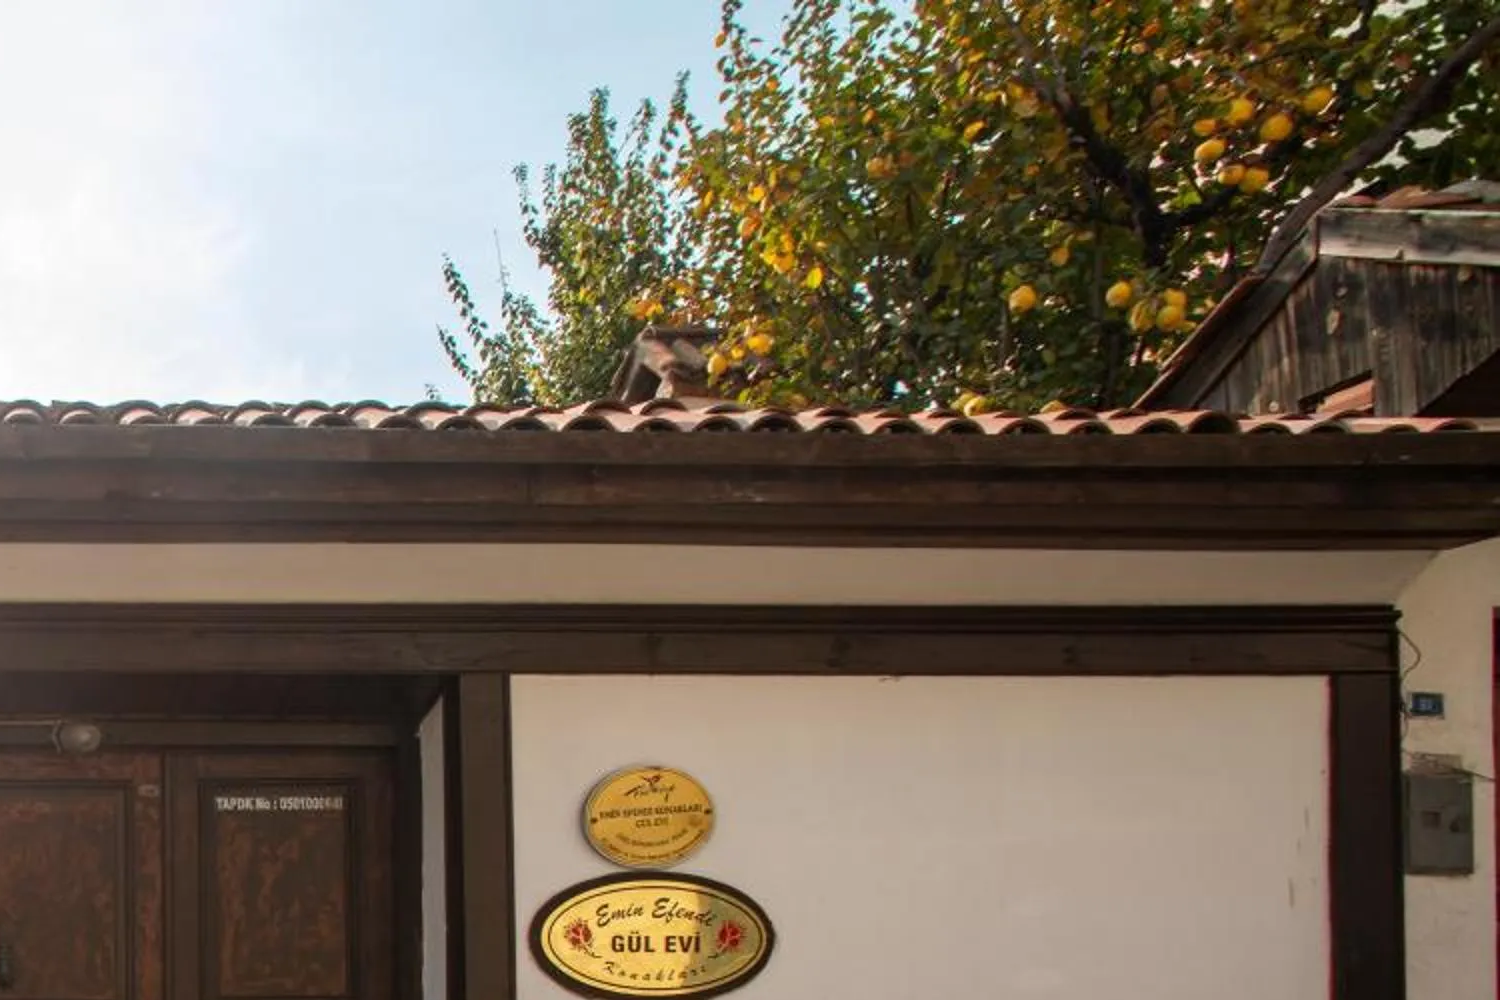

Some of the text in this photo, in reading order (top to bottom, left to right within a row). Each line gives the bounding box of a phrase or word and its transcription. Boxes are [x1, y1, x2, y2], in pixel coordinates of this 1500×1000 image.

[596, 897, 718, 928] Emin Efendi
[611, 930, 701, 953] GÜL EVİ
